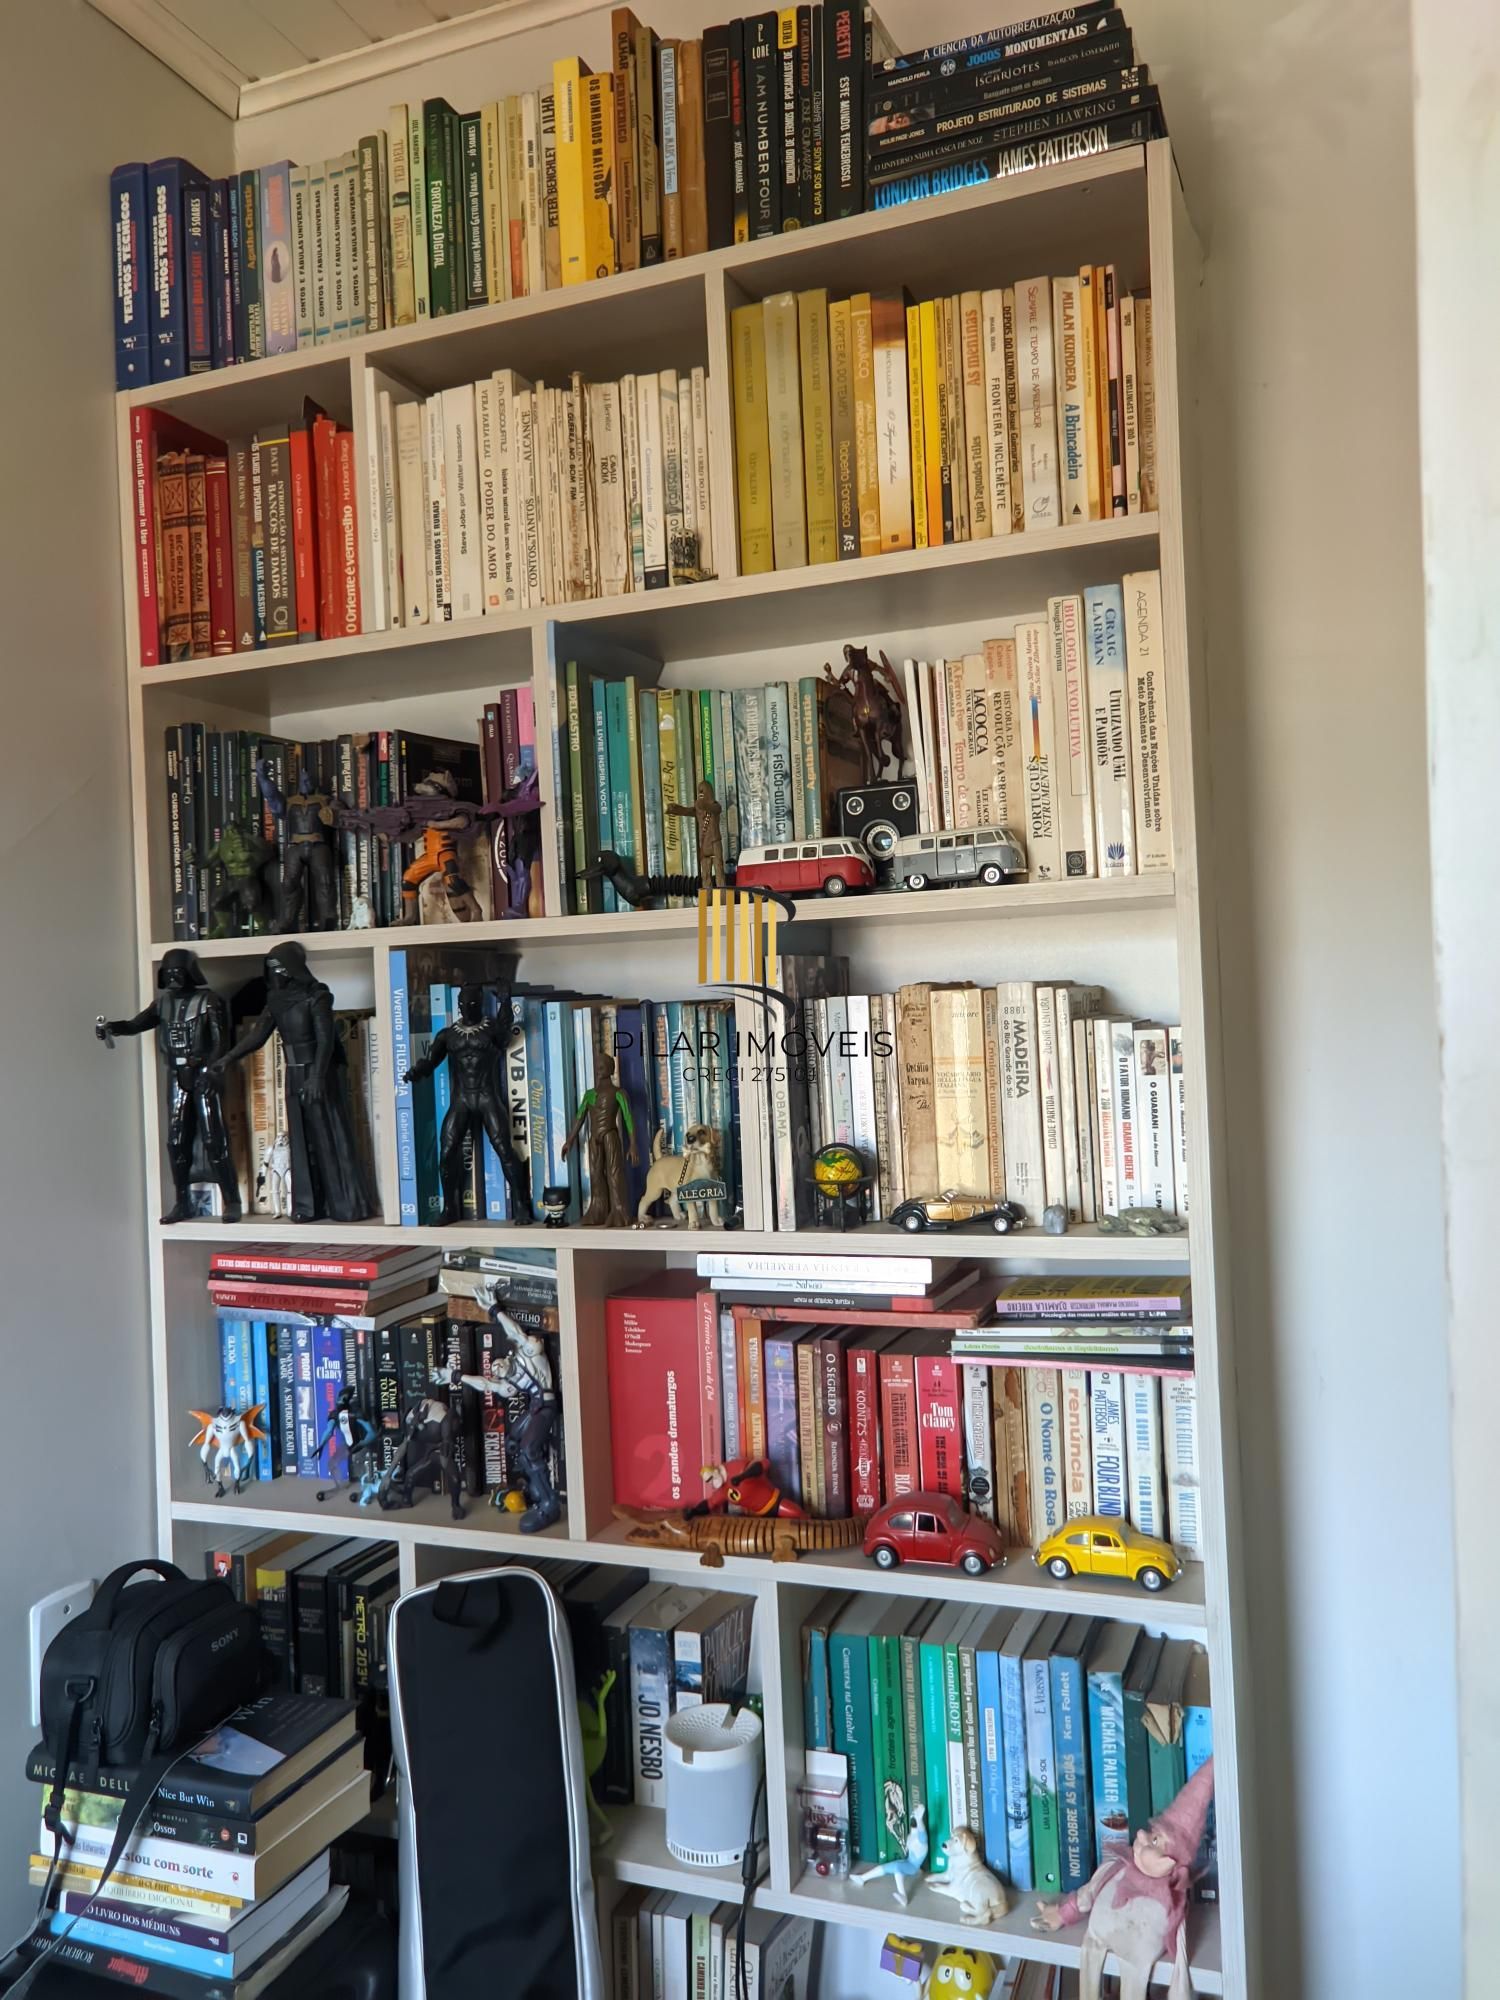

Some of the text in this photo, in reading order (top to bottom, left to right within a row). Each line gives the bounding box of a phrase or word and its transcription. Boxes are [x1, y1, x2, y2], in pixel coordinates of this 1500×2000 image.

[836, 10, 851, 59] PERETTI
[966, 24, 1088, 66] JOGOS MONUMENTAIS
[936, 79, 1107, 133] PROJETO ESTRUTURADO DE SISTEMAS
[993, 100, 1116, 141] STEPHEN HAWKING
[542, 95, 559, 228] PETER BENCHLEY A ILHA
[589, 78, 605, 200] OS HONRADOS MAFIOSOS
[756, 75, 771, 220] AM NUMBER FOUR
[996, 126, 1108, 178] JAMES PATTERSON
[874, 159, 989, 210] LONDON BRIDGES
[189, 199, 201, 236] JÔ SOARES
[245, 185, 256, 269] Agatha Christie
[431, 180, 445, 269] FORTALEZA DIGITAL
[964, 309, 980, 386] As meninas
[1062, 291, 1078, 391] MILAN KUNDERA
[455, 424, 463, 462] Isaacson
[992, 378, 1007, 510] FRONTEIRA INCLEMENTE
[1065, 404, 1079, 480] A Brincadeira
[457, 464, 465, 490] Walter
[839, 440, 852, 527] Roberto Fonseca
[432, 500, 441, 529] RURAIS
[483, 469, 497, 580] O PODER DO AMOR
[268, 484, 281, 598] BANCOS DE DADOS
[433, 539, 442, 576] URBANOS
[435, 578, 444, 608] VERDES
[1092, 602, 1104, 666] LARMAN
[1105, 608, 1116, 657] CRAIG
[1136, 590, 1150, 656] AGENDA 21
[1064, 604, 1081, 758] BIOLOGIA EVOLUTIVA
[1137, 677, 1146, 700] Meio
[568, 685, 579, 751] FIDEL CASTRO
[803, 694, 815, 791] Agatha Christie
[974, 689, 989, 755] IACOCCA
[993, 692, 1004, 757] REVOLUÇÃO
[1004, 691, 1013, 748] HISTÓRIA DA
[1095, 717, 1108, 766] PADRÕES
[1109, 690, 1123, 752] UTILIZANDO
[1138, 702, 1147, 743] Ambiente
[1146, 671, 1162, 832] Conferência das Nações Unidas sobre
[1028, 755, 1043, 839] PORTUGUÊS
[1039, 754, 1052, 838] INSTRUMENTAL
[1141, 752, 1152, 828] Desenvolvimento
[1004, 1020, 1010, 1031] do
[510, 1047, 525, 1081] VB
[1006, 1075, 1012, 1085] do
[1014, 1020, 1030, 1098] MADEIRA
[1120, 1064, 1129, 1087] FATOR
[530, 1079, 545, 1154] Obra Poética
[1121, 1089, 1130, 1119] HUMANO
[400, 1112, 411, 1176] Gabriel Chalita
[1122, 1122, 1132, 1152] GRAHAM
[1124, 1155, 1134, 1180] GREENE
[679, 1188, 724, 1199] ALEGRIA
[300, 1352, 311, 1381] PROOF
[345, 1338, 355, 1362] LILLIAN
[826, 1353, 836, 1363] O
[381, 1378, 389, 1410] TO KILL
[827, 1367, 836, 1415] SEGREDO
[931, 1403, 953, 1417] Tom
[1095, 1390, 1107, 1433] PATTERSON
[1107, 1399, 1119, 1424] JAMES
[667, 1371, 681, 1499] os grandes dramaturgos
[923, 1414, 955, 1432] Clancy
[1068, 1388, 1084, 1493] renúncia
[1176, 1406, 1193, 1465] KEN FOLLETT
[484, 1432, 500, 1484] EXCALIBUR
[1040, 1403, 1057, 1526] O Nome da Rosa
[1097, 1455, 1121, 1517] FOUR BLIND
[1179, 1493, 1197, 1544] WHITEOUT
[210, 1627, 239, 1653] SONY
[638, 1694, 660, 1718] JO
[843, 1647, 857, 1743] Conversa na Catedral
[1060, 1671, 1072, 1739] Ken Follett
[33, 1764, 130, 1792] MICAE DELL
[1101, 1706, 1119, 1801] MICHAEL PALMER
[158, 1788, 215, 1807] Nice But Win
[153, 1822, 176, 1835] Ossos
[154, 1856, 213, 1879] com sorte
[95, 1906, 181, 1936] LIVRO DOS MÉDIUNS
